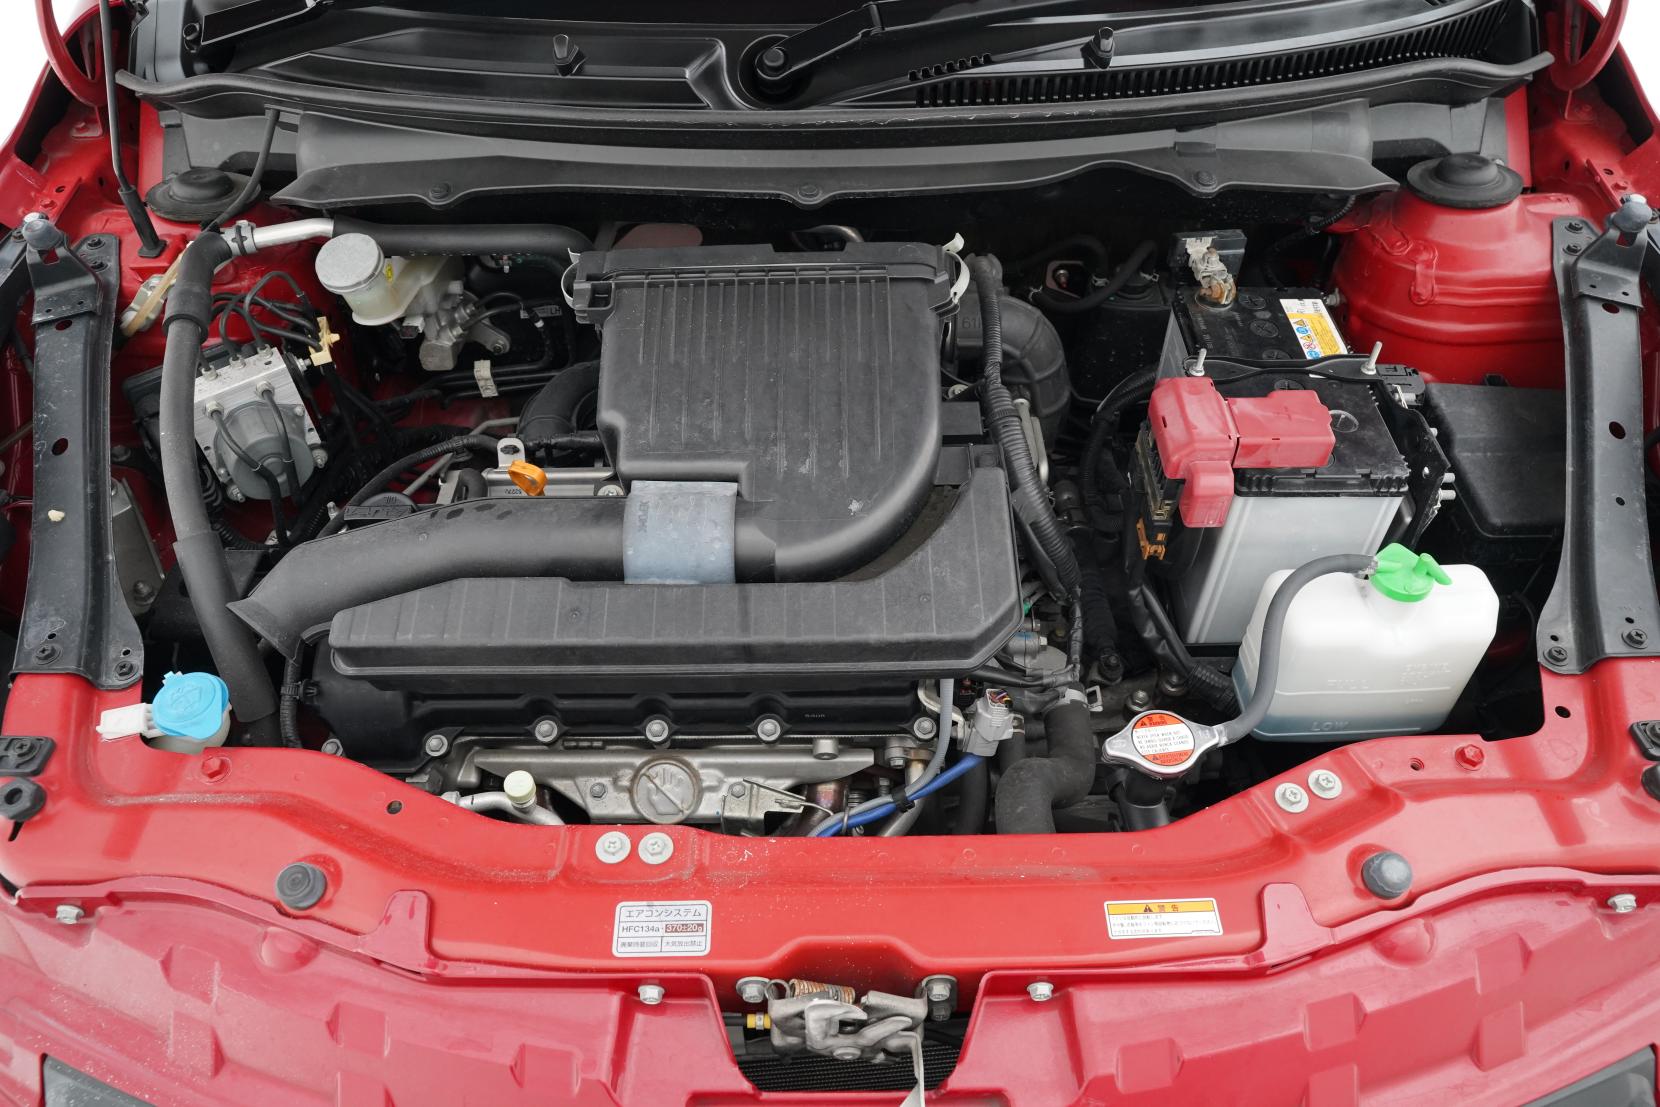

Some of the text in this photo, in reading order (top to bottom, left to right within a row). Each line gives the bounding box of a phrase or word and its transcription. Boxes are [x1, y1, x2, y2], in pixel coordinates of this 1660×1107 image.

[1312, 721, 1349, 731] LOW
[625, 908, 701, 918] エアコンシステム
[622, 925, 660, 933] HFC134a
